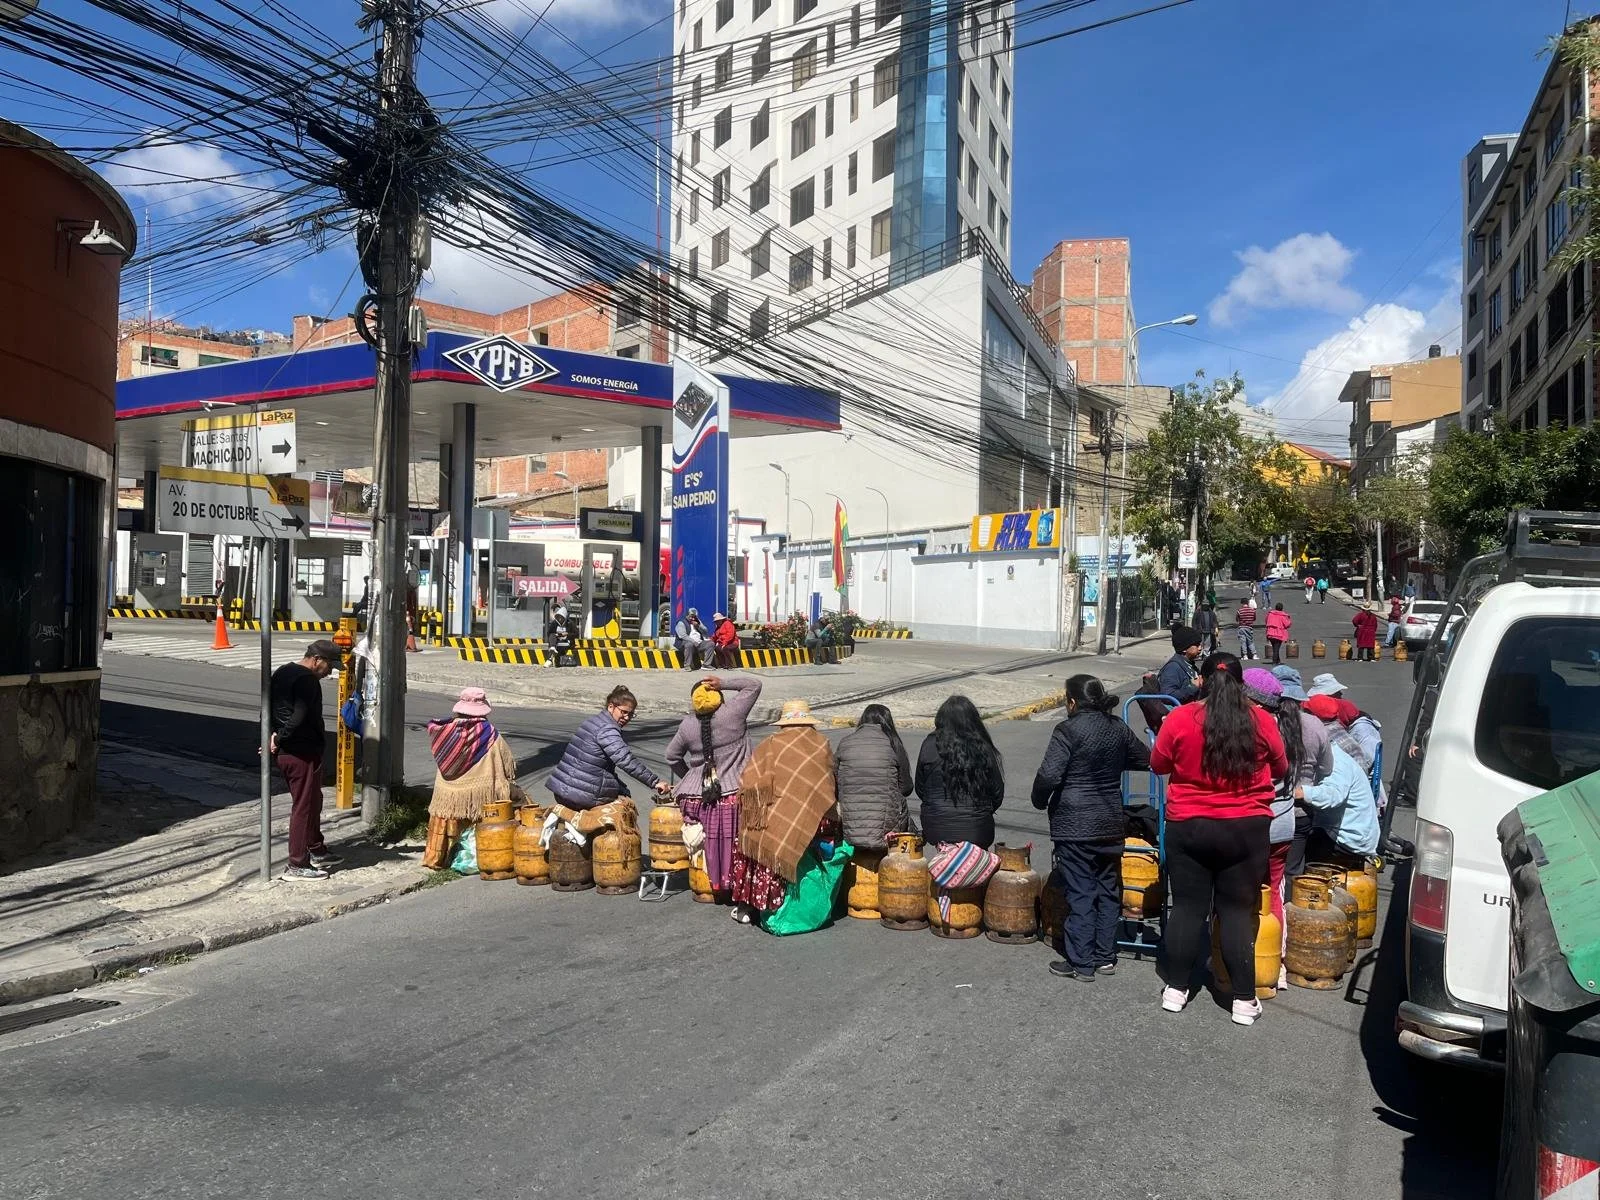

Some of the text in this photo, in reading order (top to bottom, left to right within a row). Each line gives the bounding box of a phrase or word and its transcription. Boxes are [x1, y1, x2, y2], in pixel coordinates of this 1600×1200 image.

[469, 344, 535, 382] YPFB
[571, 374, 639, 391] SOMOS ENERGÍA
[191, 433, 248, 447] CALLE: Santos
[191, 446, 252, 466] MACHICADO
[168, 484, 186, 497] AV.
[673, 490, 716, 509] SAN PEDRO
[172, 501, 260, 521] 20 DE OCTUBRE
[518, 579, 568, 594] SALIDA
